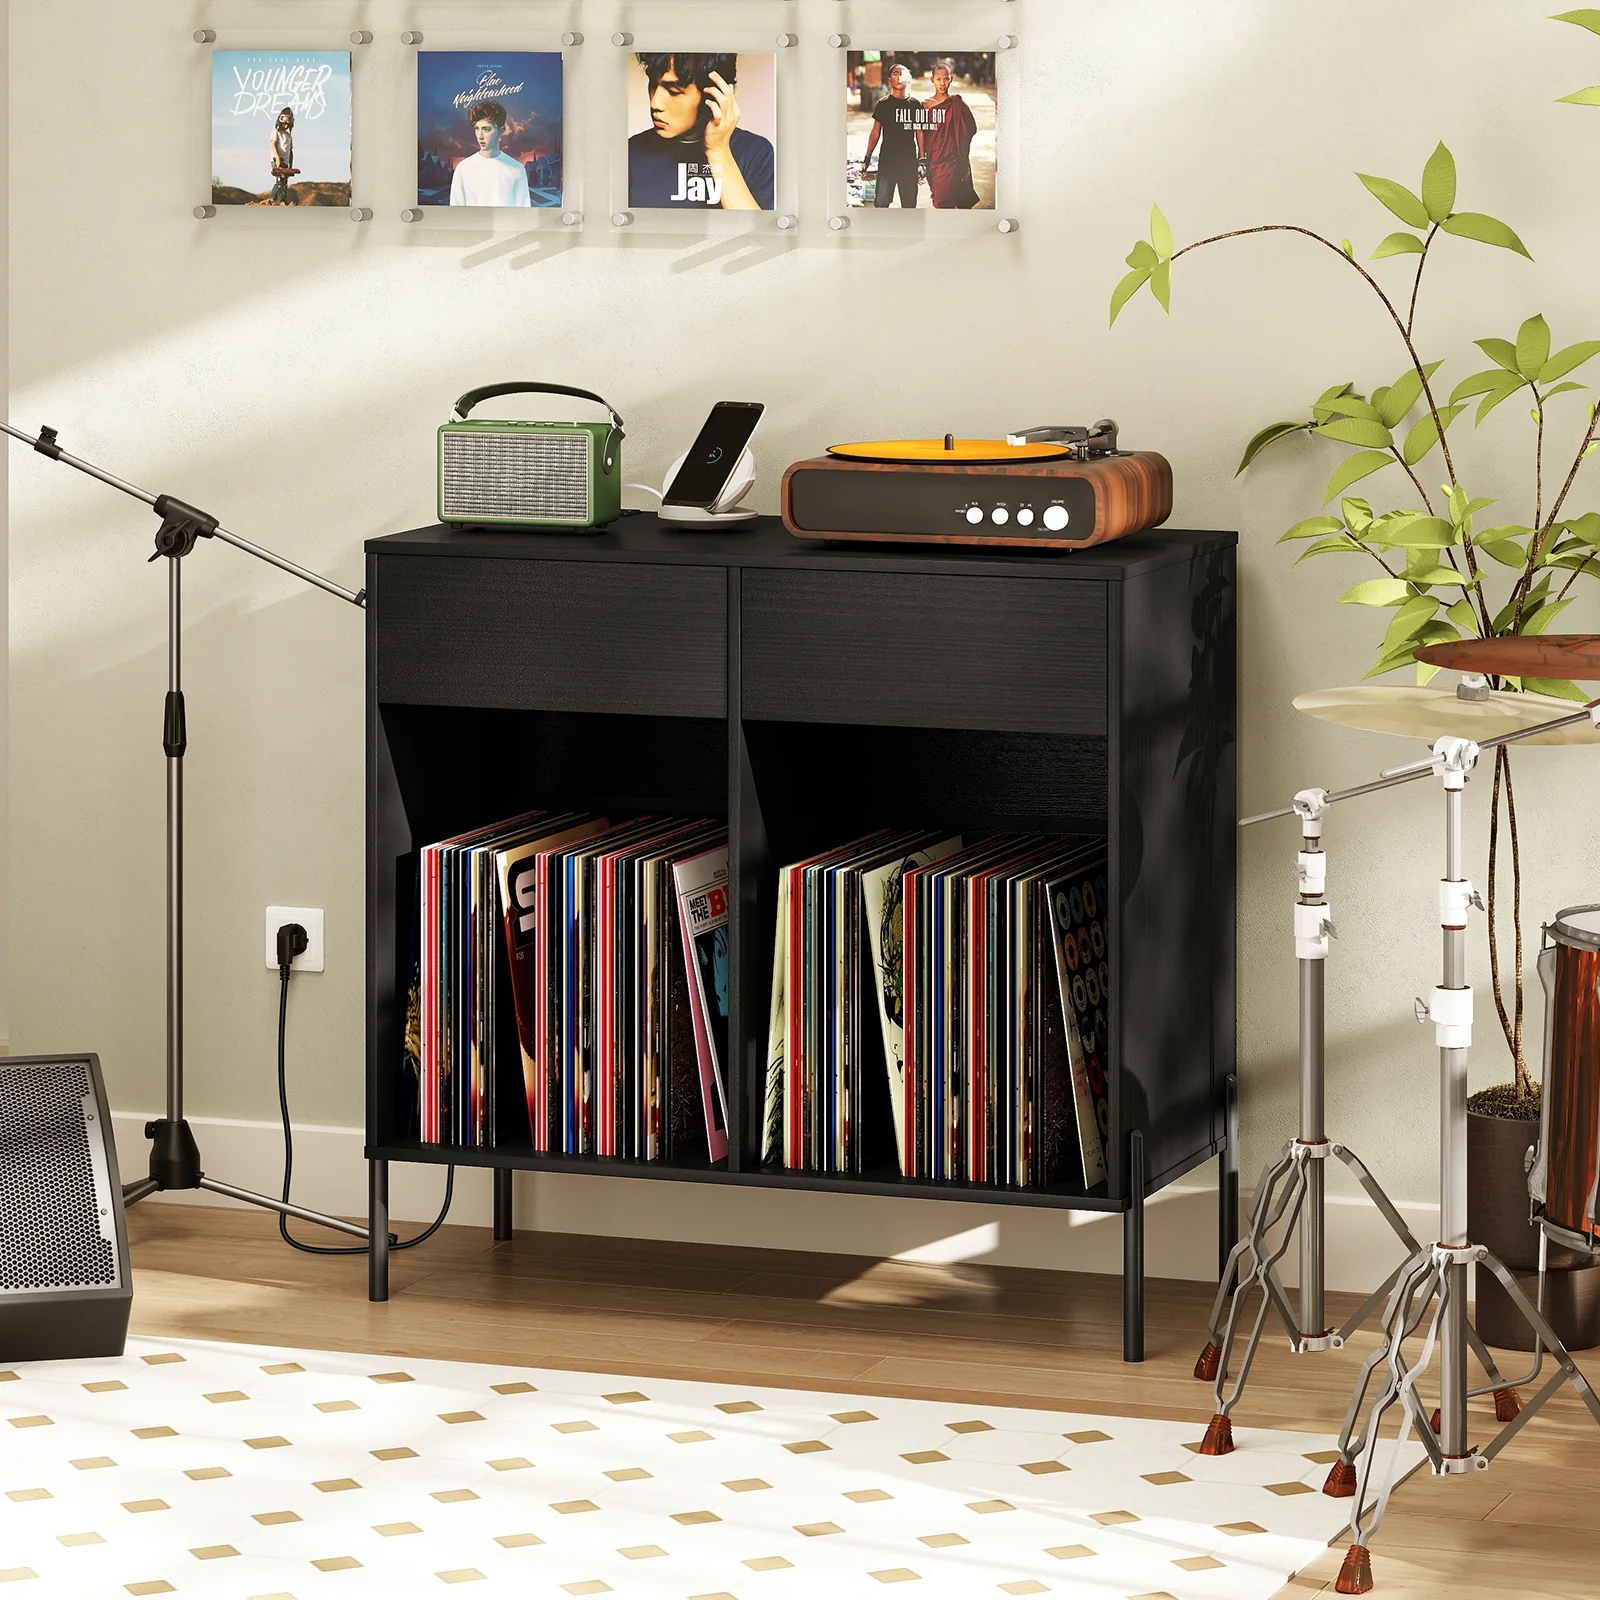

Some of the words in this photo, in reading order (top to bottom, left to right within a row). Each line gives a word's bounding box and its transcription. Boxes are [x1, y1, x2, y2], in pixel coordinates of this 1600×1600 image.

[232, 64, 332, 95] YOUNGER
[476, 69, 502, 88] Blue
[229, 91, 327, 120] DREAMS
[895, 108, 912, 123] FALL
[915, 108, 929, 123] OUT
[932, 108, 946, 123] BOY
[670, 162, 723, 205] Jay
[689, 894, 708, 911] MEET
[691, 906, 710, 924] THE
